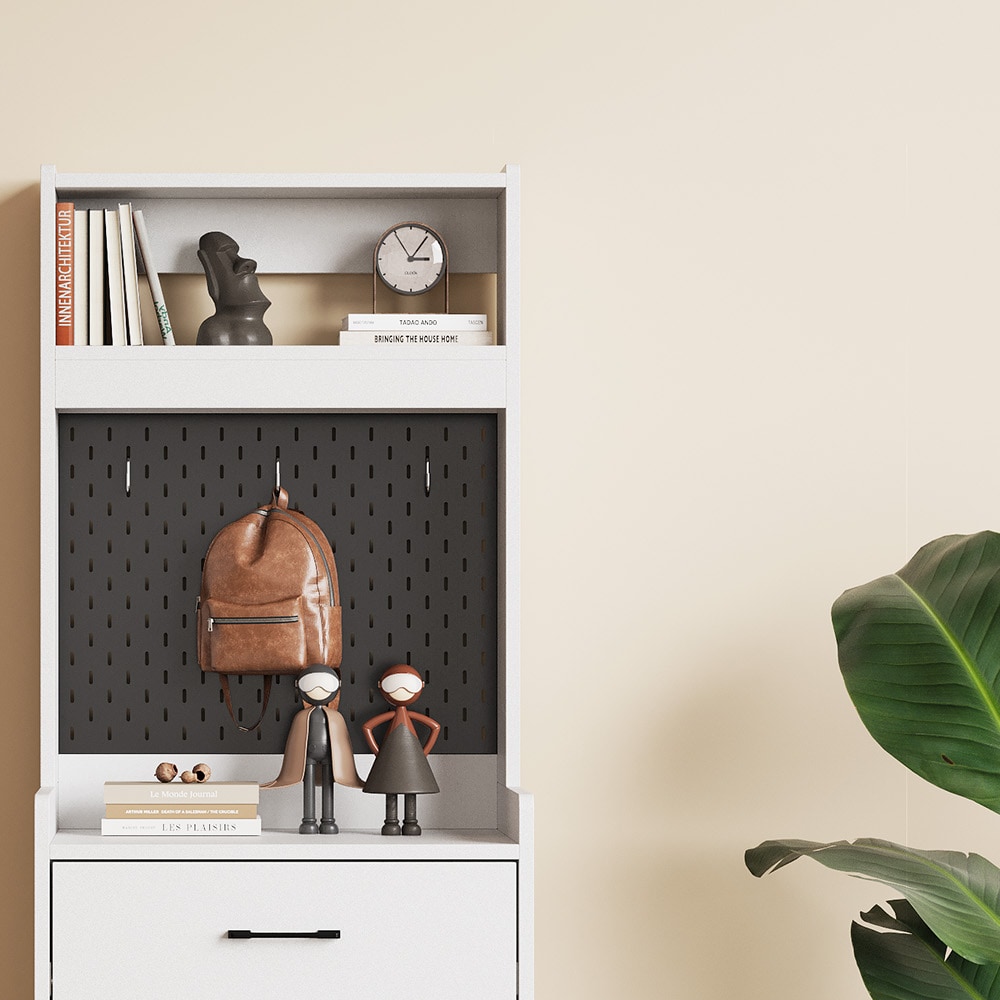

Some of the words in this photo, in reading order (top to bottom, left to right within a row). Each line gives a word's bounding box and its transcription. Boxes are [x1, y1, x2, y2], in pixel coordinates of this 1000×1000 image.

[58, 209, 72, 327] INNENARCHITEKTUR
[374, 335, 404, 343] BRINGING
[405, 335, 418, 343] THE
[419, 335, 439, 343] HOUSE
[441, 335, 459, 343] HOME
[150, 790, 160, 798] Le
[161, 790, 188, 798] Monde
[190, 790, 218, 799] Journal
[162, 823, 182, 832] LES
[186, 823, 237, 832] PLAISIRS
